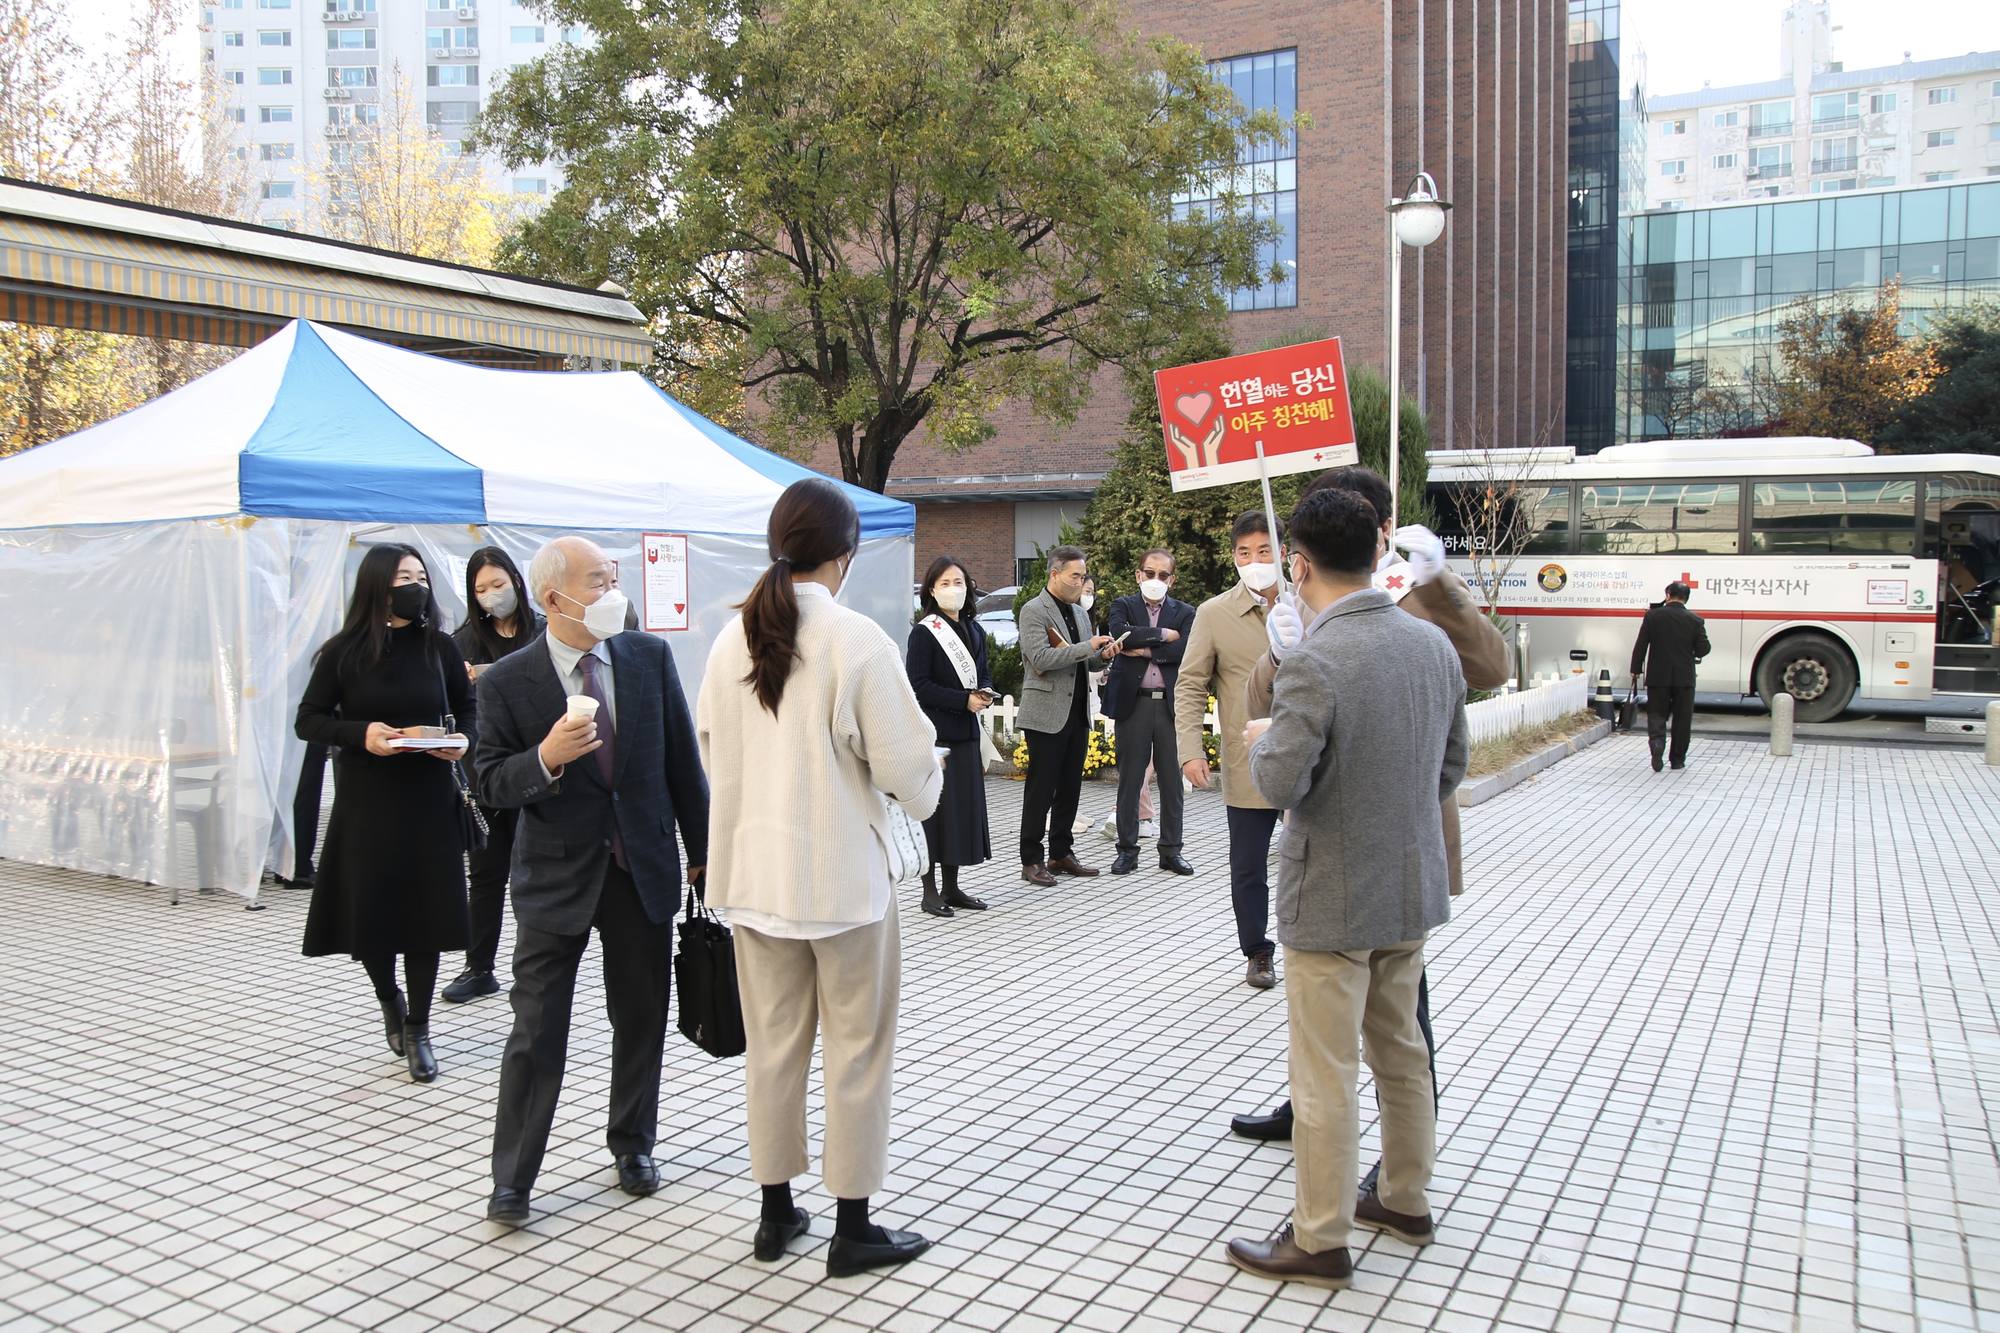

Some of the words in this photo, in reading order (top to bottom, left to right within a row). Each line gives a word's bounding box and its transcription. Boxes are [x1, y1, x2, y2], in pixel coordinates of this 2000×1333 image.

[1219, 376, 1290, 409] 헌혈하는
[1291, 363, 1336, 396] 당신
[1231, 410, 1268, 434] 아주
[1272, 398, 1335, 428] 칭찬해!
[1706, 577, 1811, 596] 대한적십자사
[1913, 589, 1925, 604] 3
